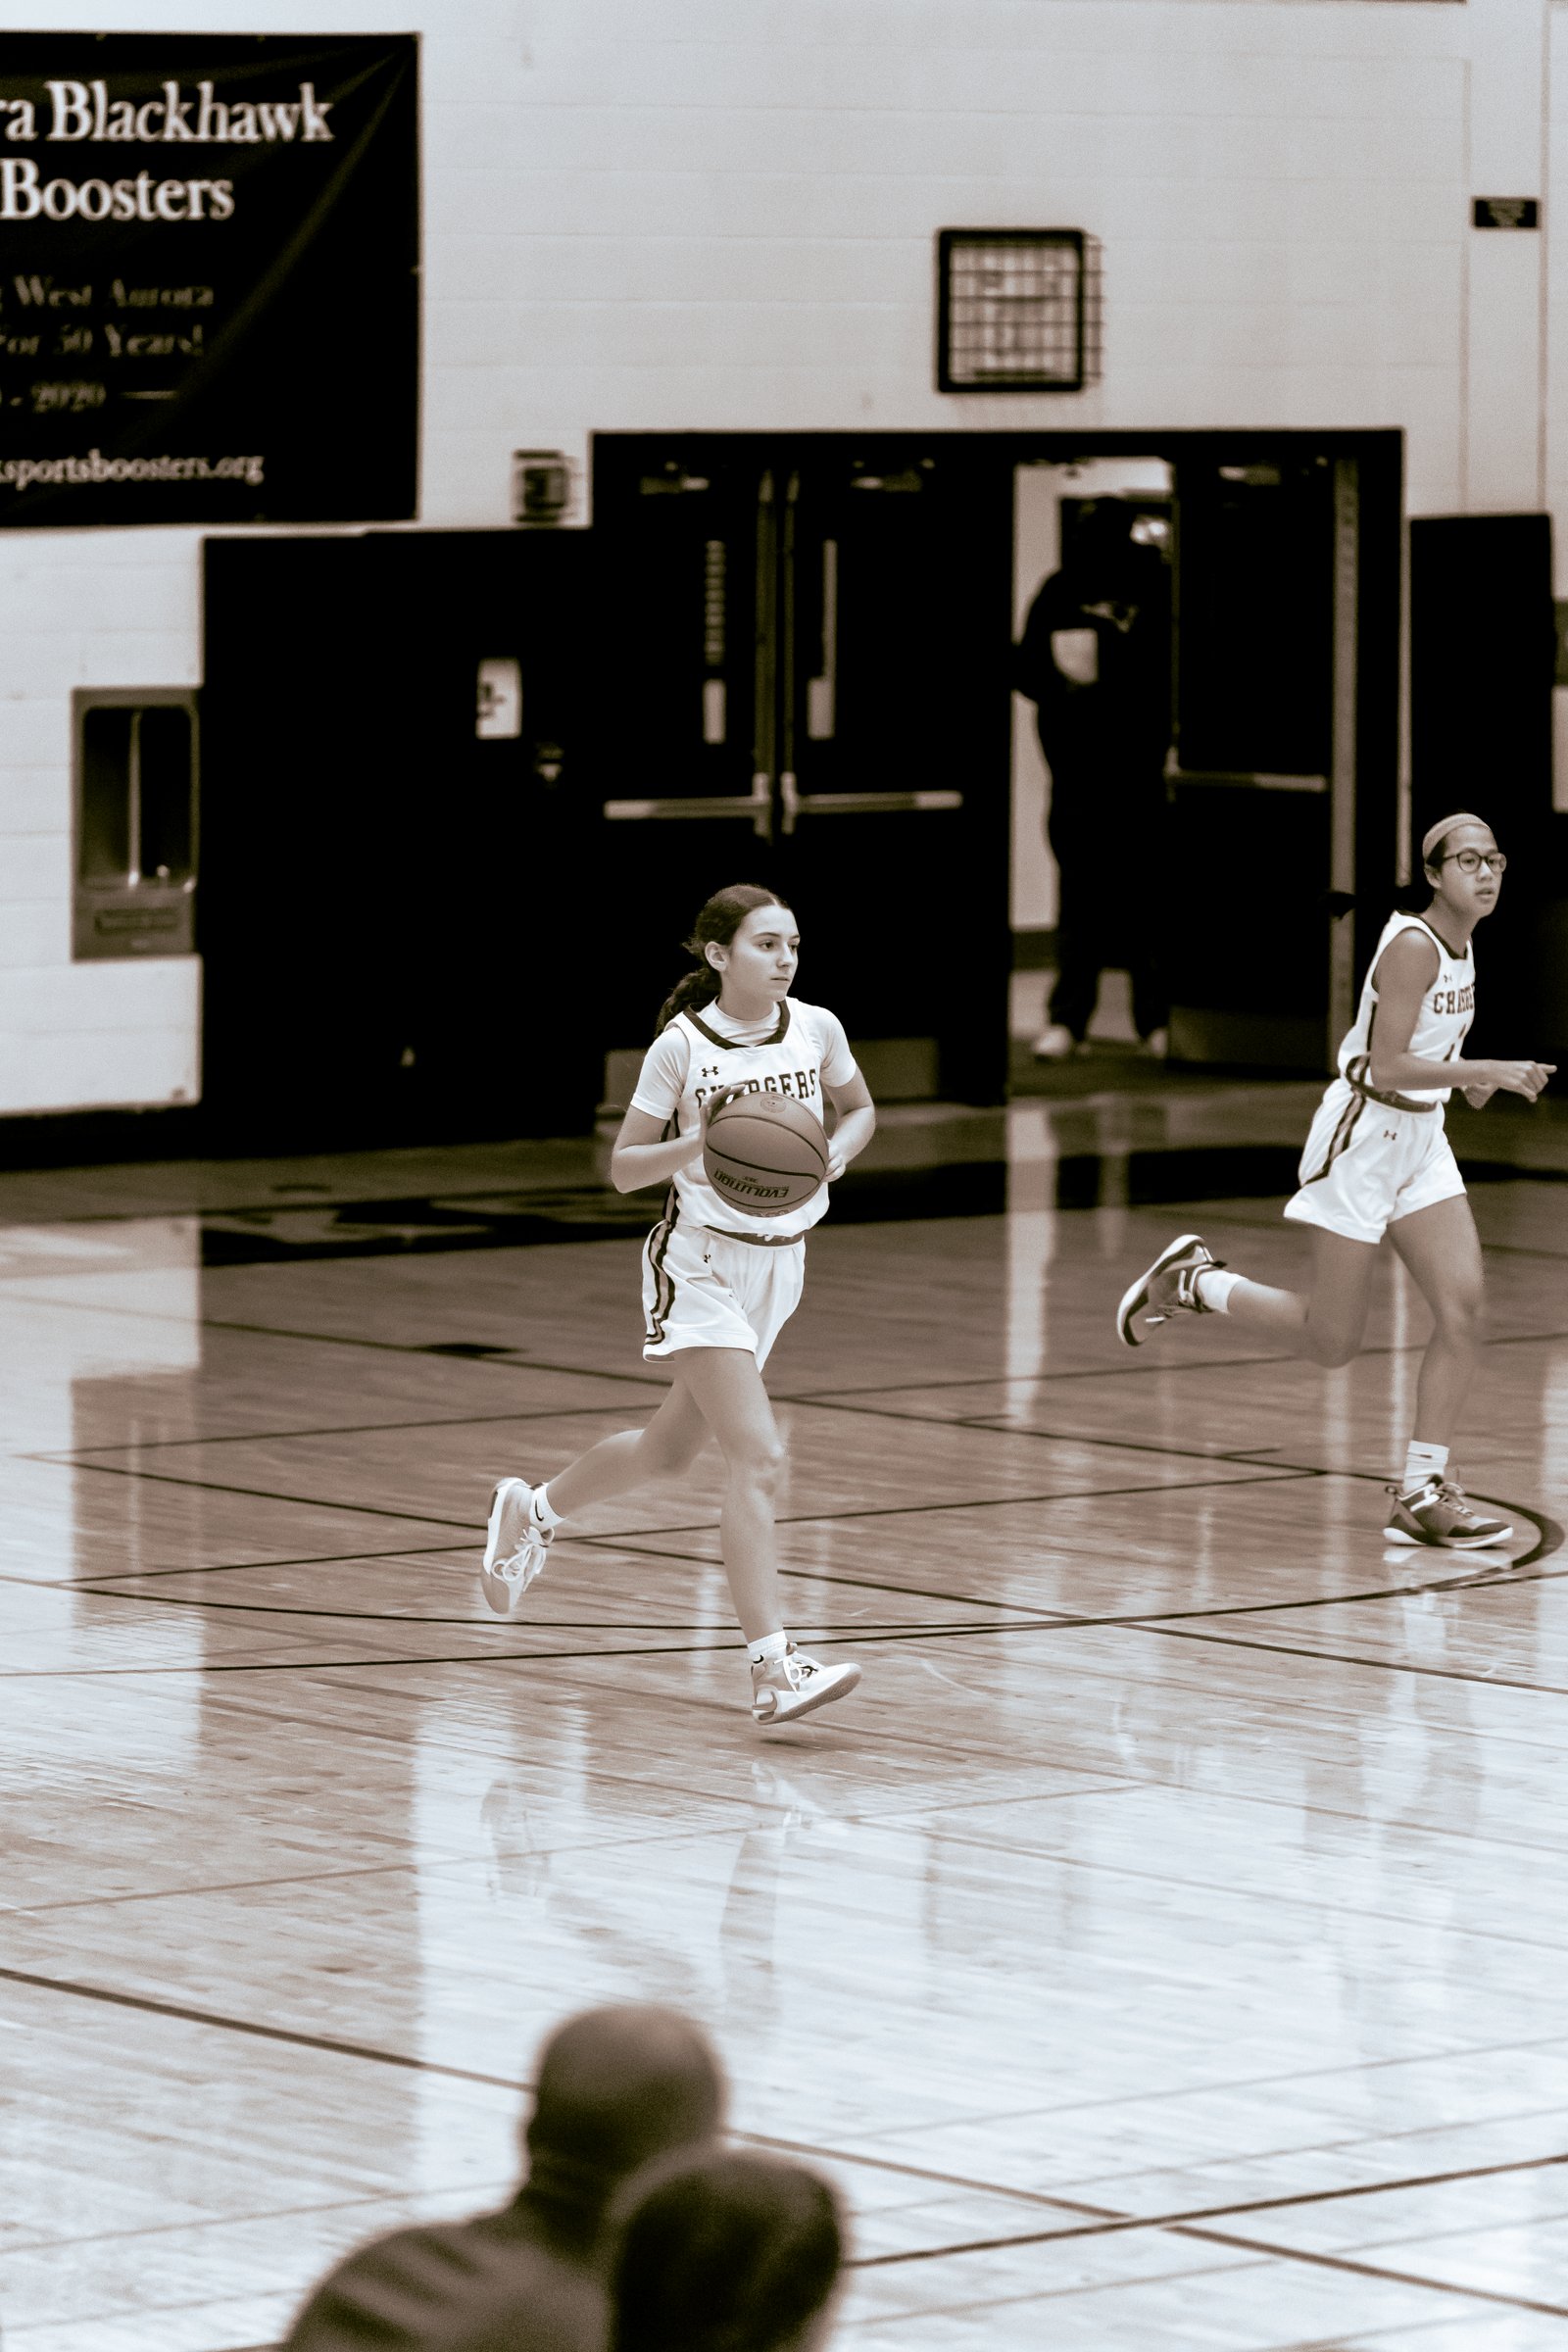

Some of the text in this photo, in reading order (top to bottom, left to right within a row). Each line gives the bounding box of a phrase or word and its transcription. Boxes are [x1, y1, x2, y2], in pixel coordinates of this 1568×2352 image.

[43, 80, 335, 143] Blackhawk
[0, 157, 236, 221] Boosters
[713, 1169, 789, 1198] EVOLUTION
